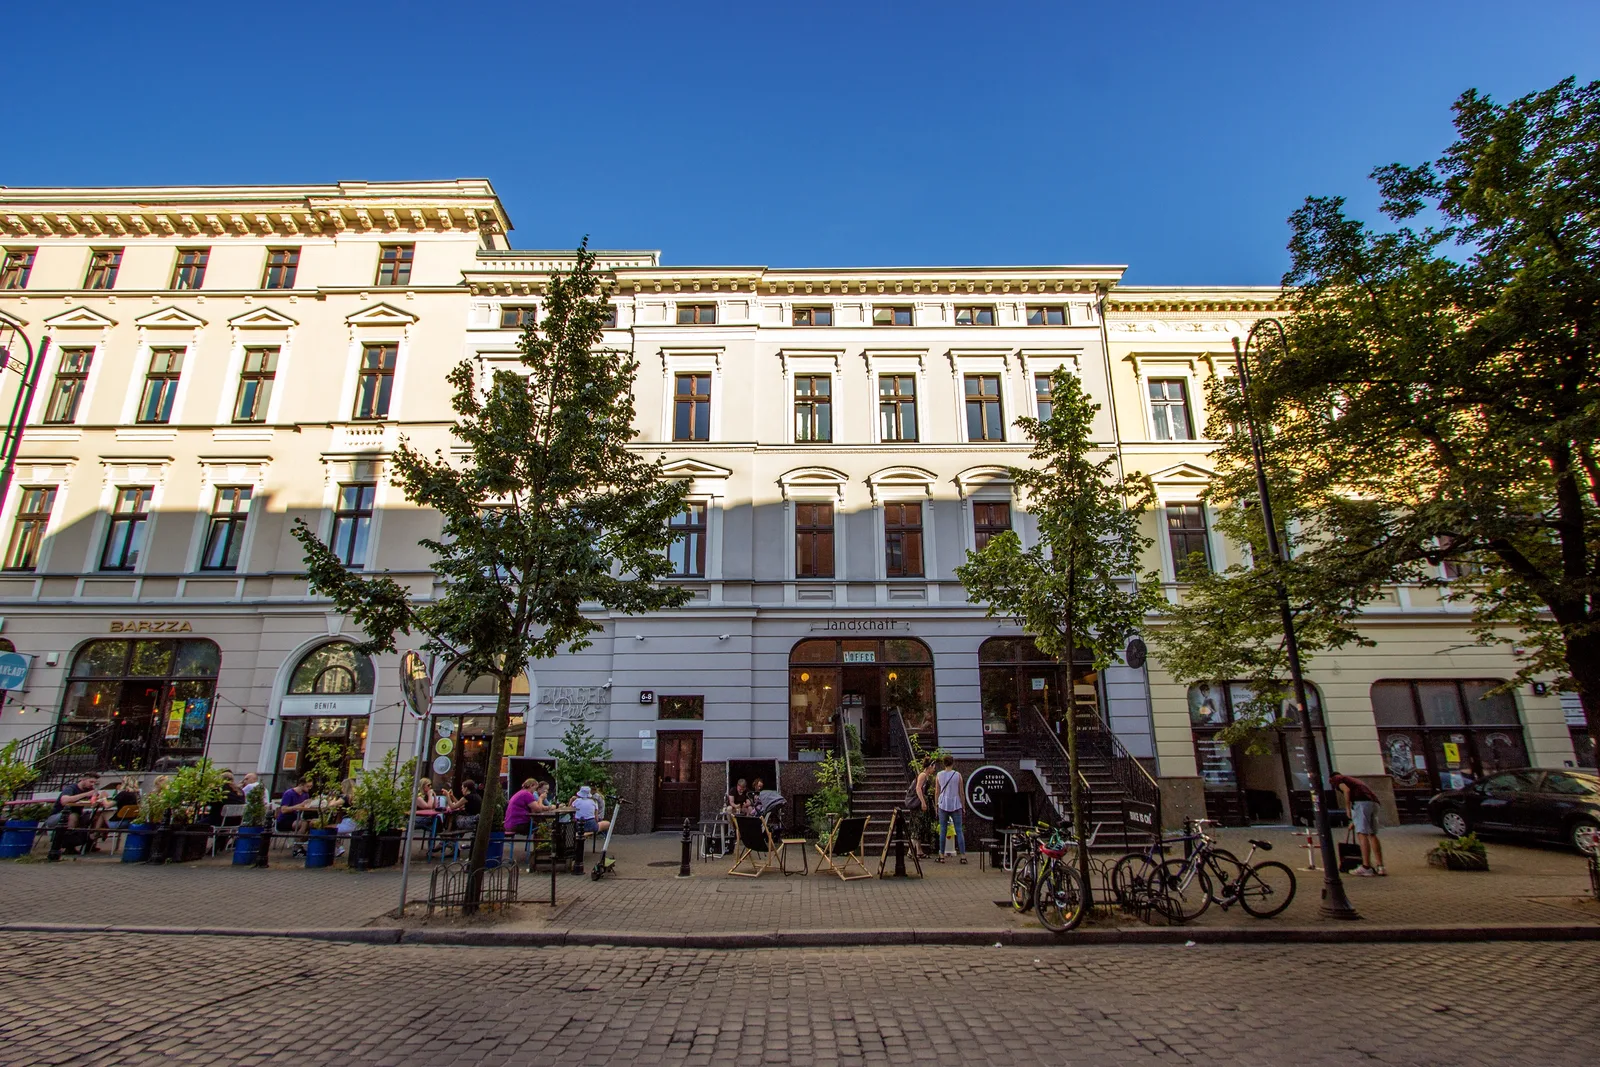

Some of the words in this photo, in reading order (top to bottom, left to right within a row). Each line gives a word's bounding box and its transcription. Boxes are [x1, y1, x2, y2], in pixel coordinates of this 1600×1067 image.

[110, 621, 193, 632] BARZZA
[541, 687, 607, 704] BURGER
[314, 702, 337, 710] BENITA
